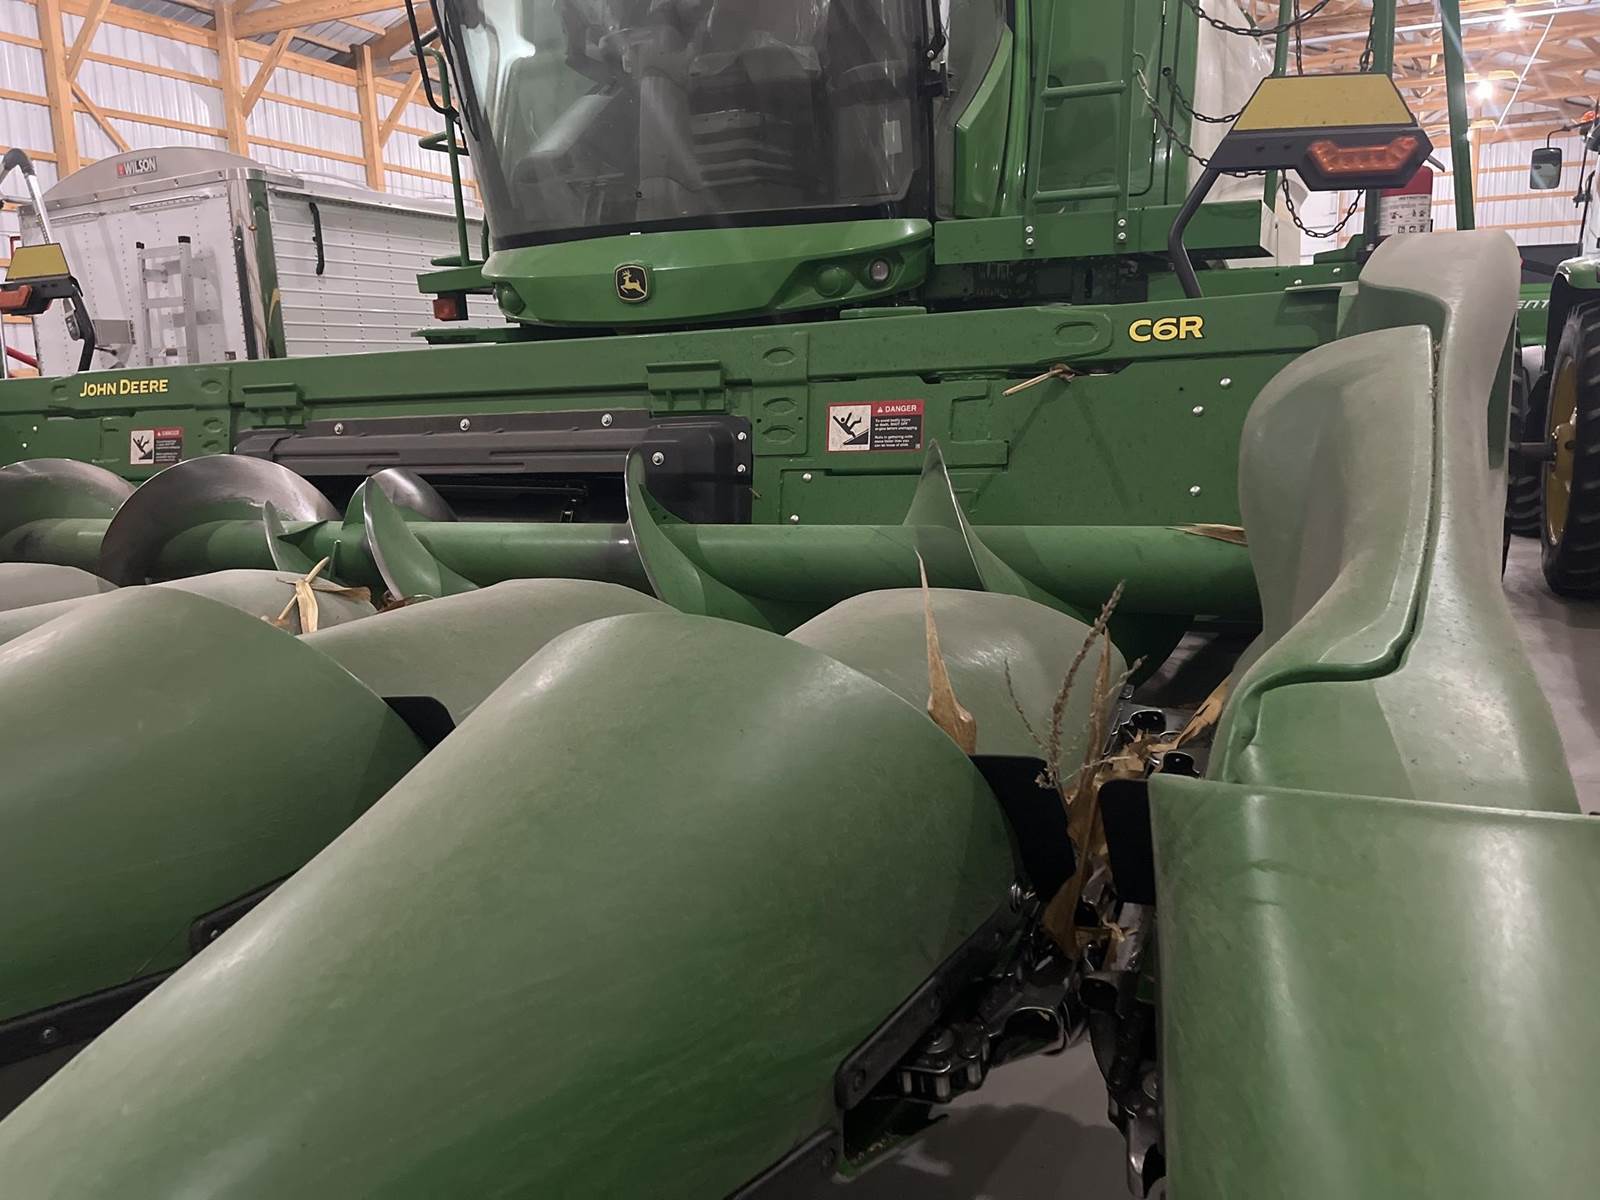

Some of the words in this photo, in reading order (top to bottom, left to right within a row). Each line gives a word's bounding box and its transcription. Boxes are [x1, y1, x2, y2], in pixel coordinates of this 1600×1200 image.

[124, 156, 157, 175] WILSON
[1129, 315, 1205, 343] C6R
[79, 382, 117, 397] JOHN
[119, 379, 169, 394] DEERE
[885, 404, 917, 413] DANGER
